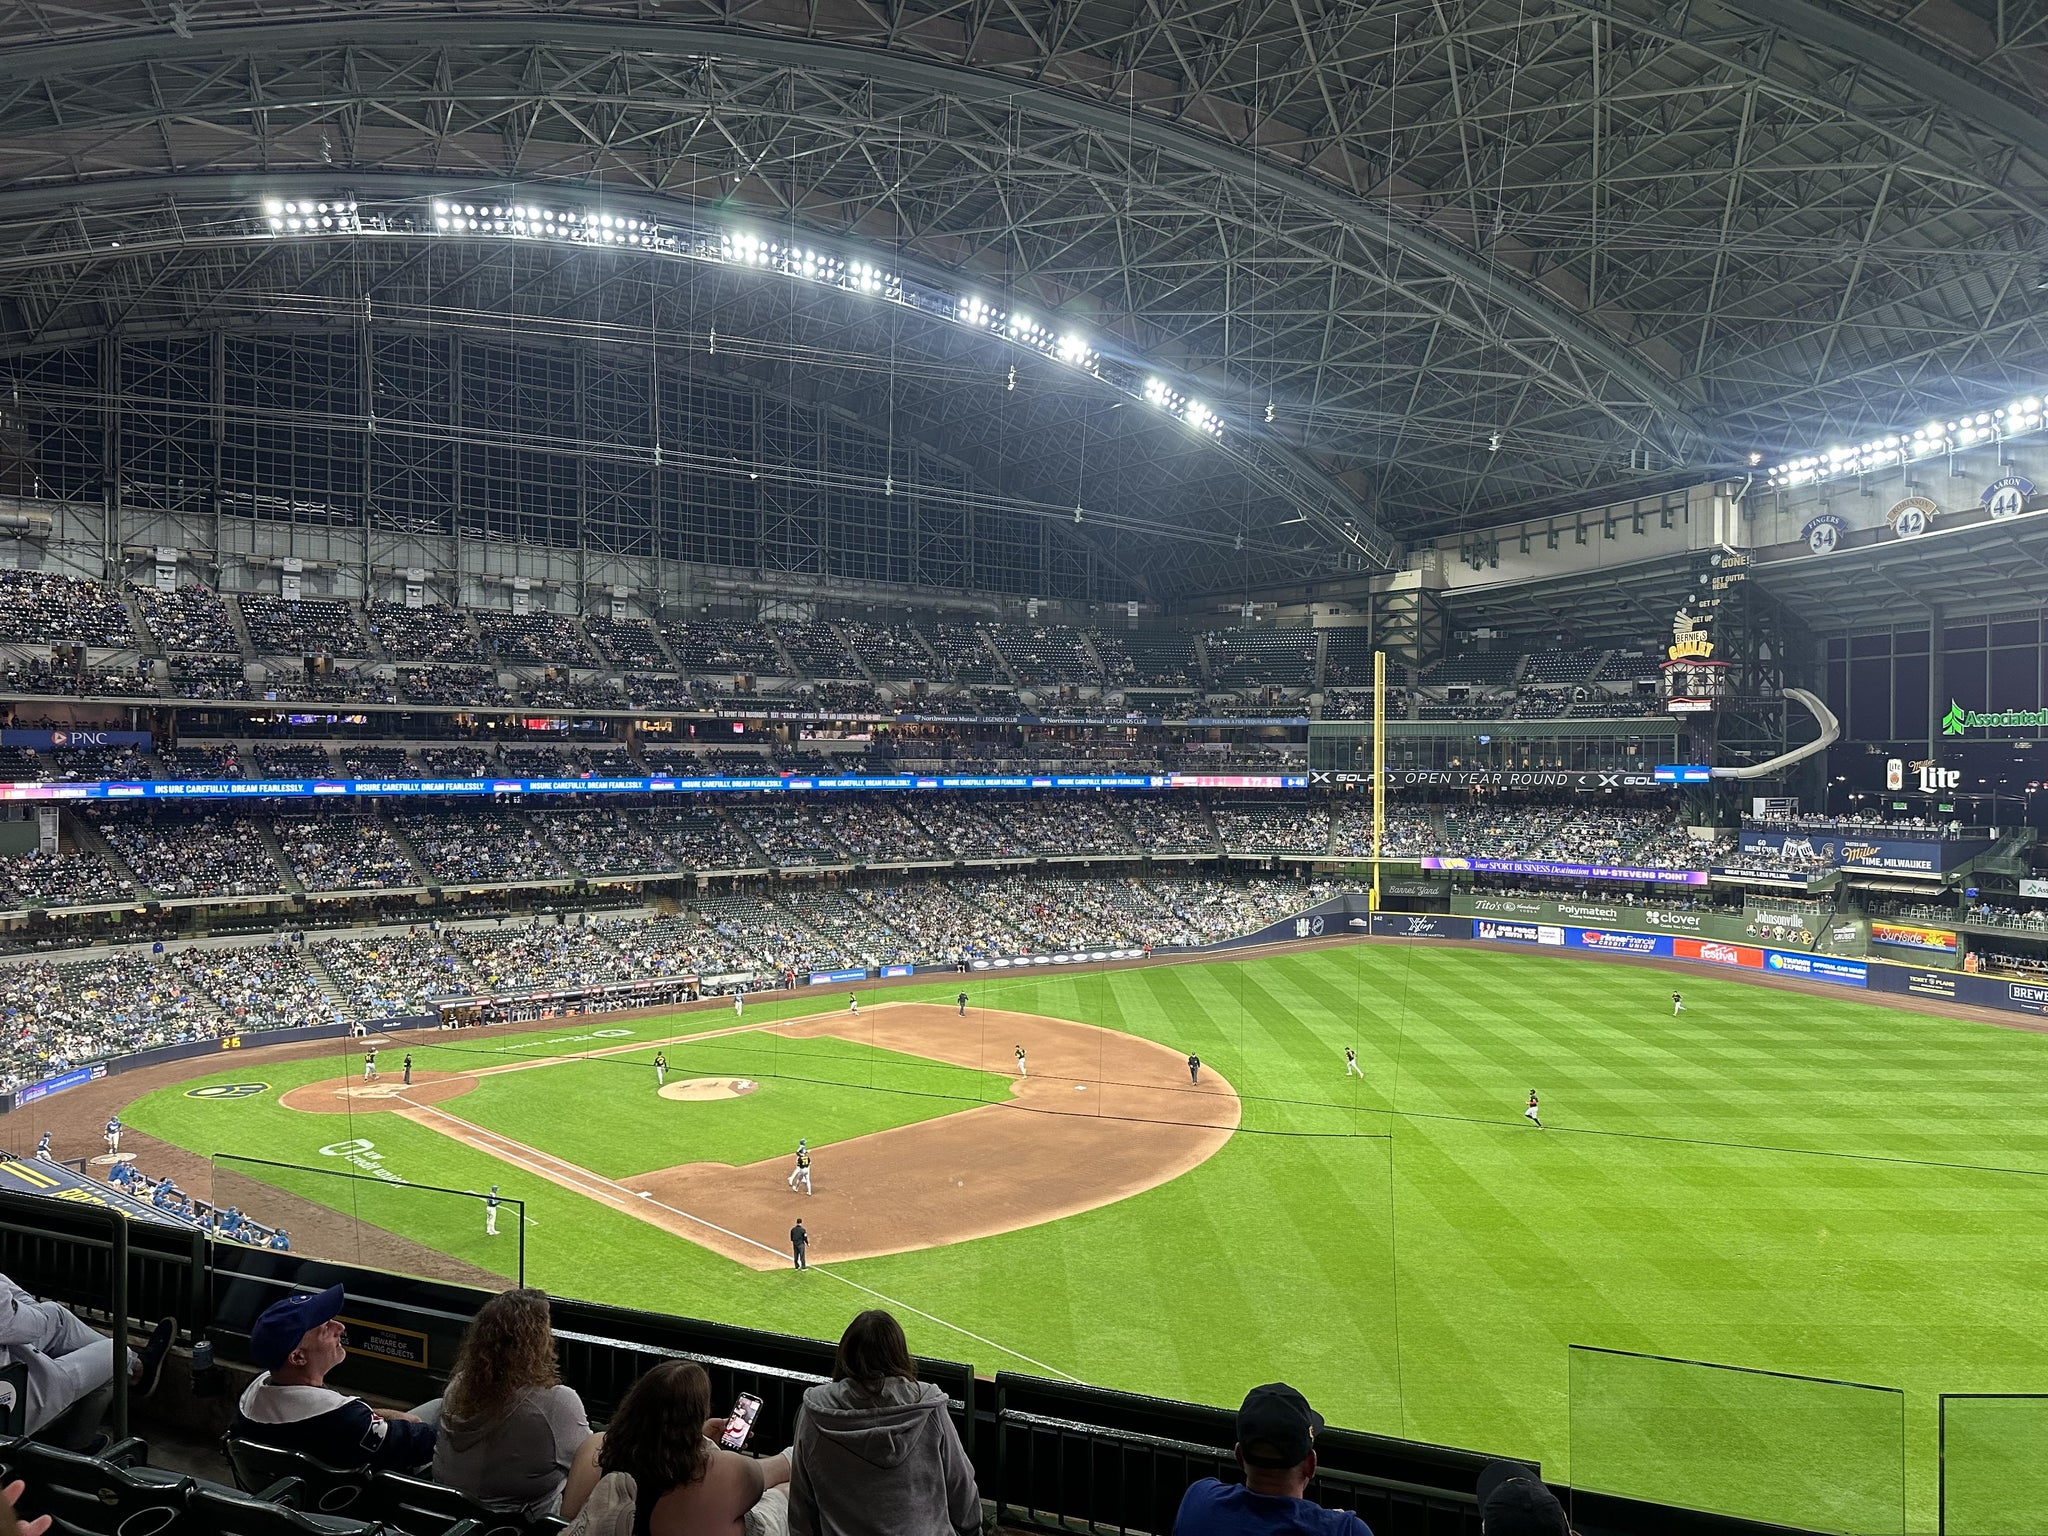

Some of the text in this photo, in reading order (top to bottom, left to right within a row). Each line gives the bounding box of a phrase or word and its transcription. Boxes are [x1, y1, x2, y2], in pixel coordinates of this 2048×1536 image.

[1993, 477, 2020, 492] AARON
[1892, 498, 1930, 515] ROBINSON
[1994, 494, 2017, 515] 44
[1808, 516, 1839, 529] FINGERS
[1899, 513, 1922, 533] 42
[1813, 529, 1832, 549] 34
[1721, 555, 1750, 568] GONE!
[1712, 573, 1745, 584] GET OUTTA
[1712, 582, 1729, 590] HERE
[1699, 600, 1710, 608] GET
[1703, 614, 1713, 622] UP
[1676, 631, 1707, 643] BERNIE'S
[1668, 641, 1714, 661] CHALET
[1965, 708, 2048, 727] Associated
[70, 732, 108, 744] PNC
[1336, 774, 1374, 782] GOLF
[1405, 773, 1568, 785] OPEN YEAR ROUND
[1624, 776, 1660, 785] GOL
[1918, 767, 1960, 793] Lite
[155, 785, 184, 794] INSURE
[232, 785, 258, 793] DREAM
[355, 782, 380, 792] INSURE
[422, 782, 444, 791] DREAM
[530, 782, 551, 790] INSURE
[588, 781, 607, 789] DREAM
[1841, 847, 1882, 863] Miller
[1862, 858, 1932, 869] TIME, MILWAUKEE
[1475, 861, 1688, 880] Your SPORT BUSINESS Destination UW-STEVENS POINT
[1389, 886, 1439, 896] Barrel Yard
[1475, 900, 1501, 911] Tito's
[1558, 904, 1617, 918] Polymatech
[1660, 912, 1700, 925] clover
[1755, 910, 1803, 928] Johnsonville
[1881, 928, 1923, 944] Surfside
[1629, 942, 1654, 950] UNION
[1701, 945, 1737, 962] festival
[371, 1336, 396, 1348] BEWARE
[364, 1342, 414, 1359] FLYING OBJECTS
